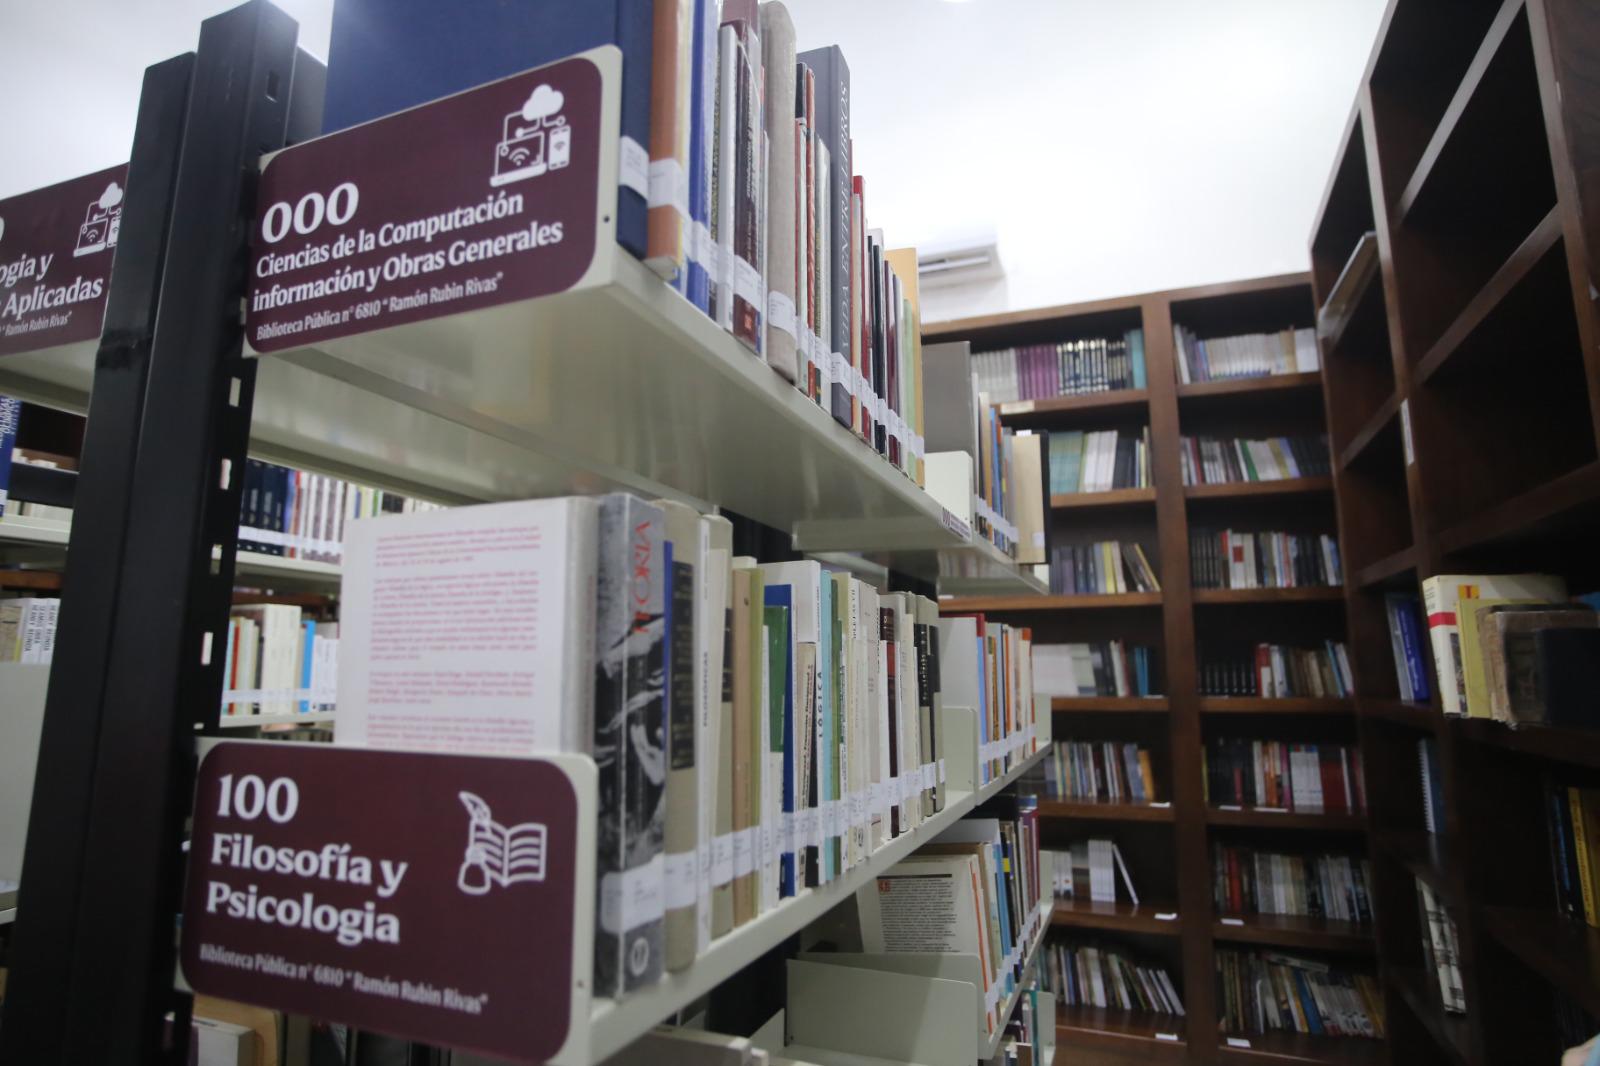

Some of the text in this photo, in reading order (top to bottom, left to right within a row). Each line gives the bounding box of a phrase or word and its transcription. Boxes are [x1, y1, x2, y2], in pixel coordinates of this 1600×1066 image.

[256, 190, 523, 278] Ciencias de la Computación
[262, 182, 359, 243] 000
[36, 253, 54, 280] y
[366, 266, 381, 293] y
[383, 250, 445, 281] Obras
[448, 220, 563, 266] Generales
[2, 275, 104, 320] Aplicadas
[256, 318, 303, 340] Biblioteca
[304, 309, 341, 331] Pública
[355, 300, 381, 319] 6810
[217, 774, 299, 823] 100
[211, 832, 408, 898] Filosofía y
[206, 880, 400, 947] Psicologia
[200, 943, 254, 970] Biblioteca
[255, 952, 298, 978] Pública
